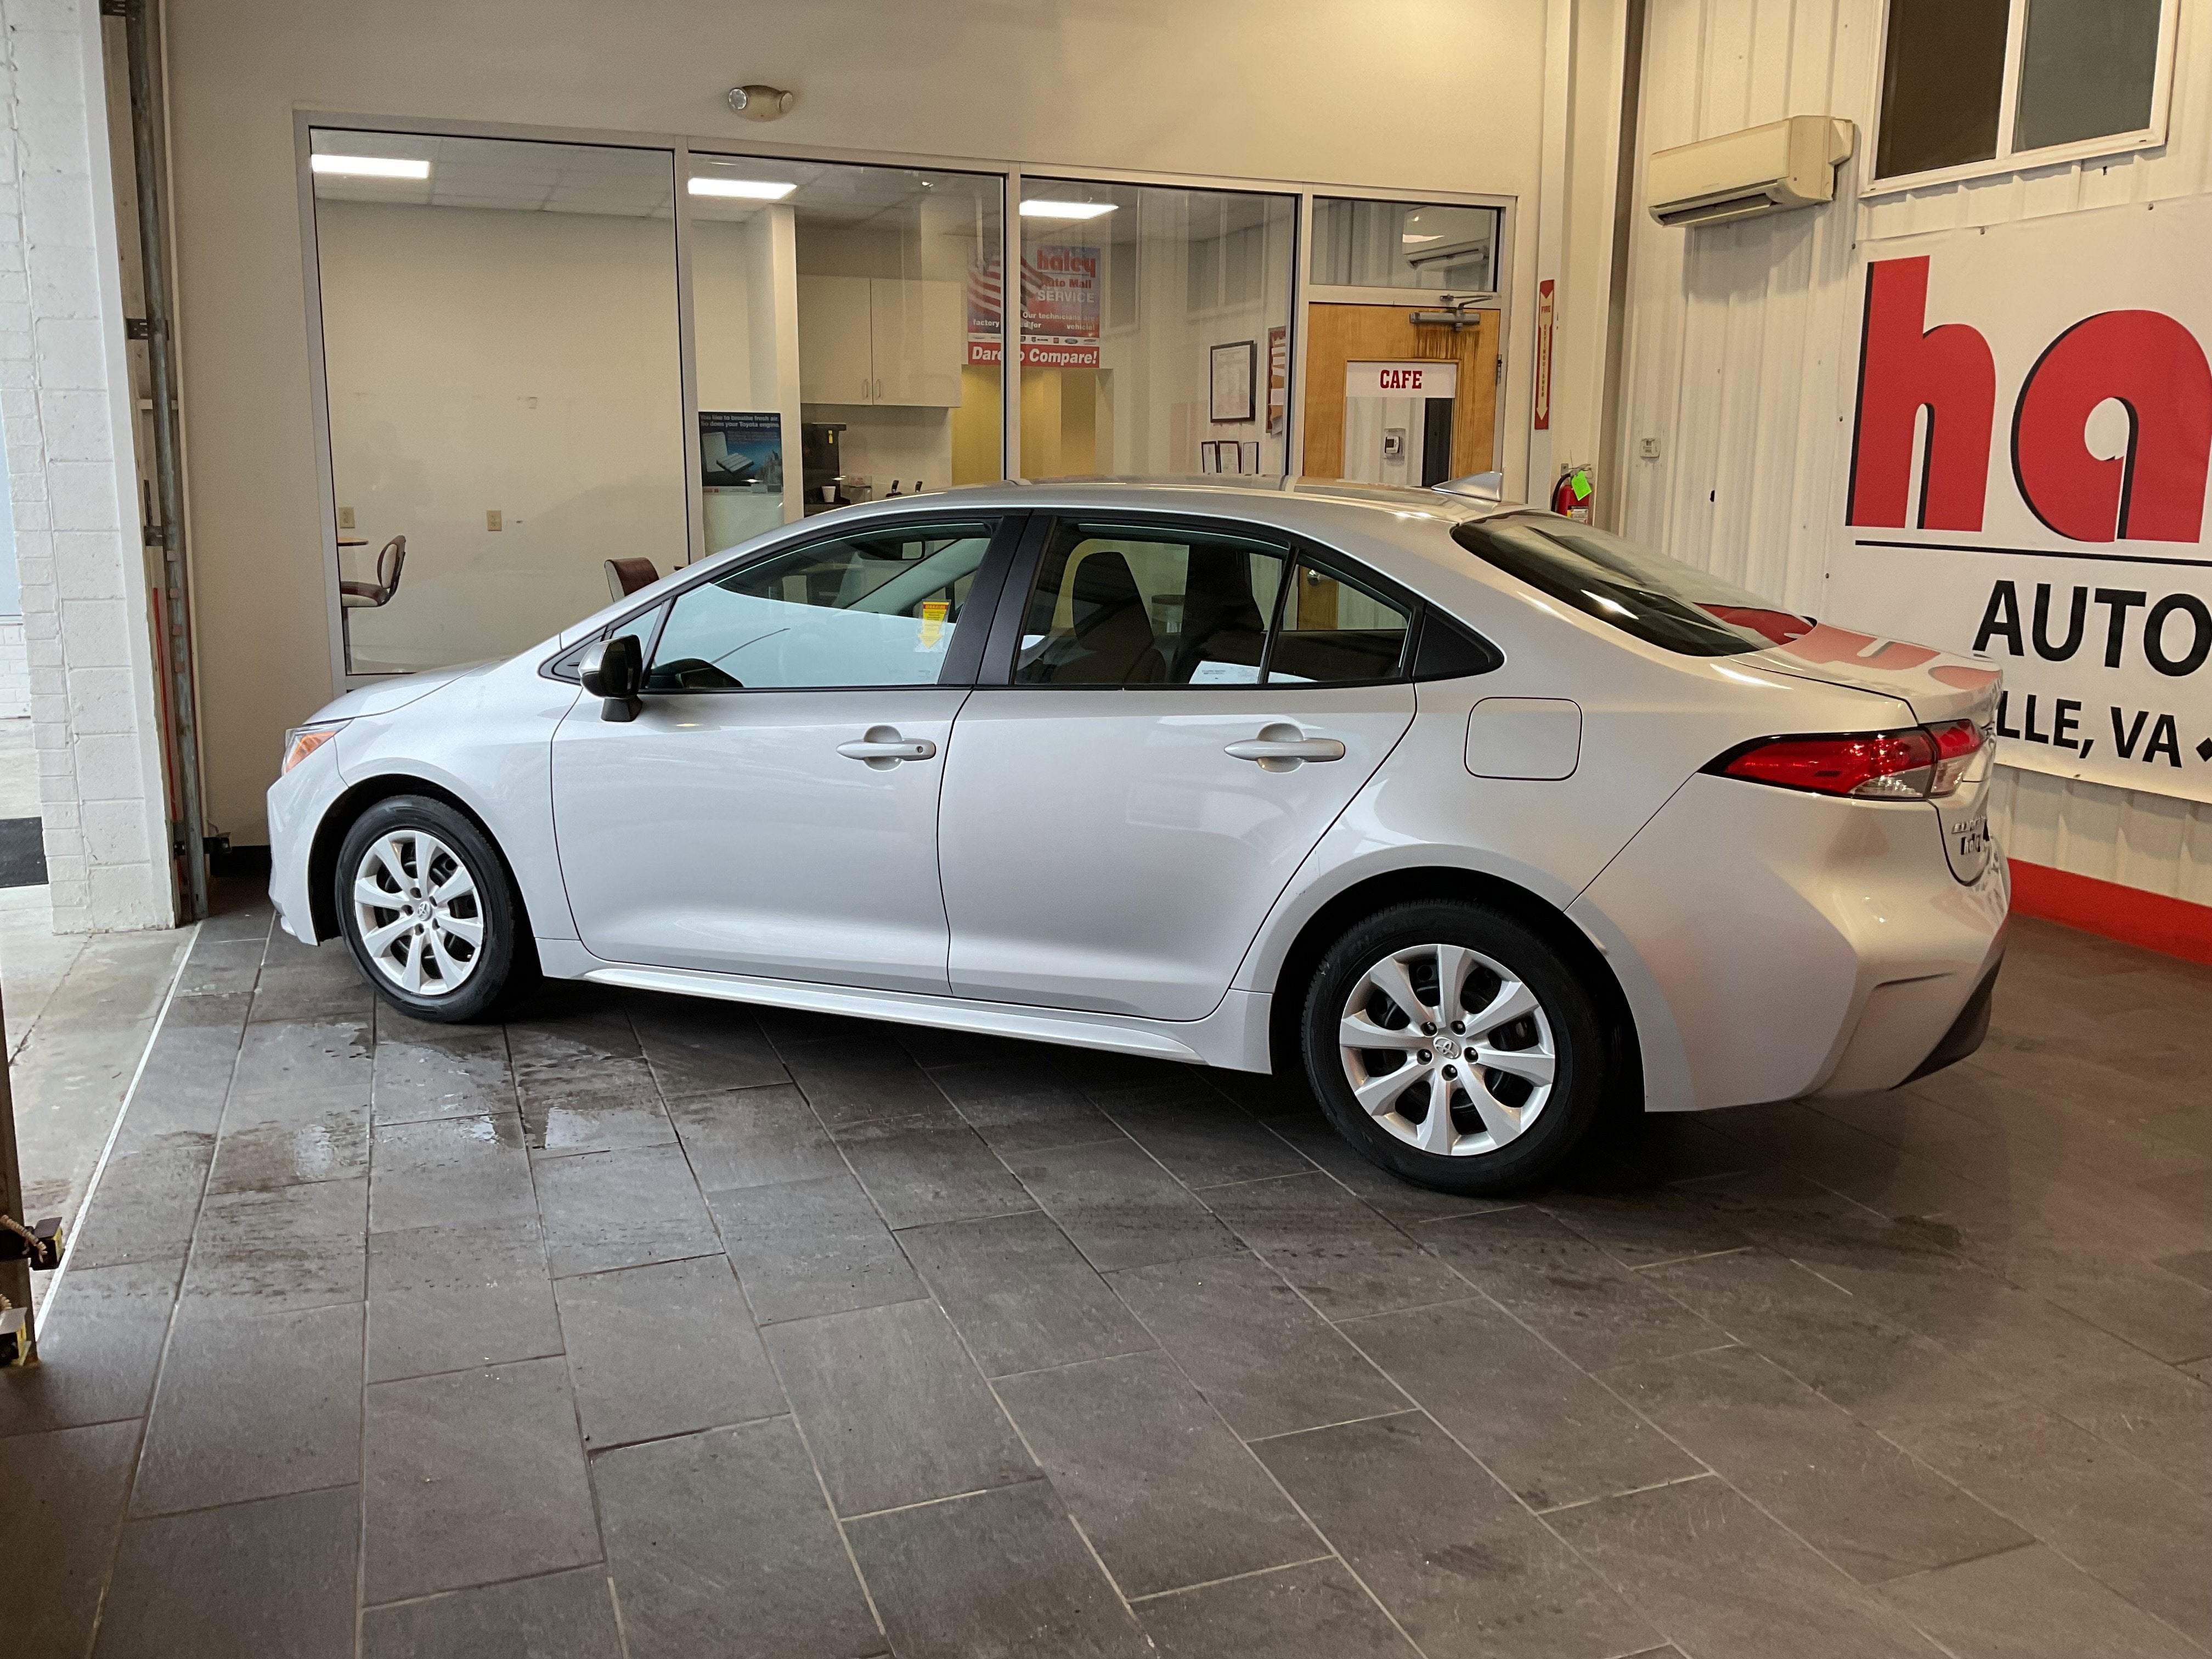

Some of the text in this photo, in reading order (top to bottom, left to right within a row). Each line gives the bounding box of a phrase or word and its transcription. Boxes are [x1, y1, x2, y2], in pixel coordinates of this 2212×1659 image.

[1036, 249, 1096, 278] haley
[1069, 278, 1091, 289] Mall
[1036, 290, 1094, 303] SERVICE
[1039, 313, 1081, 321] technicians
[1541, 305, 1551, 314] FIRE
[973, 319, 1000, 328] factory
[1029, 348, 1097, 366] Compare!
[1380, 369, 1423, 389] CAFE
[1845, 255, 2212, 543] ha
[1972, 580, 2212, 677] AUTO
[2111, 706, 2182, 768] VA
